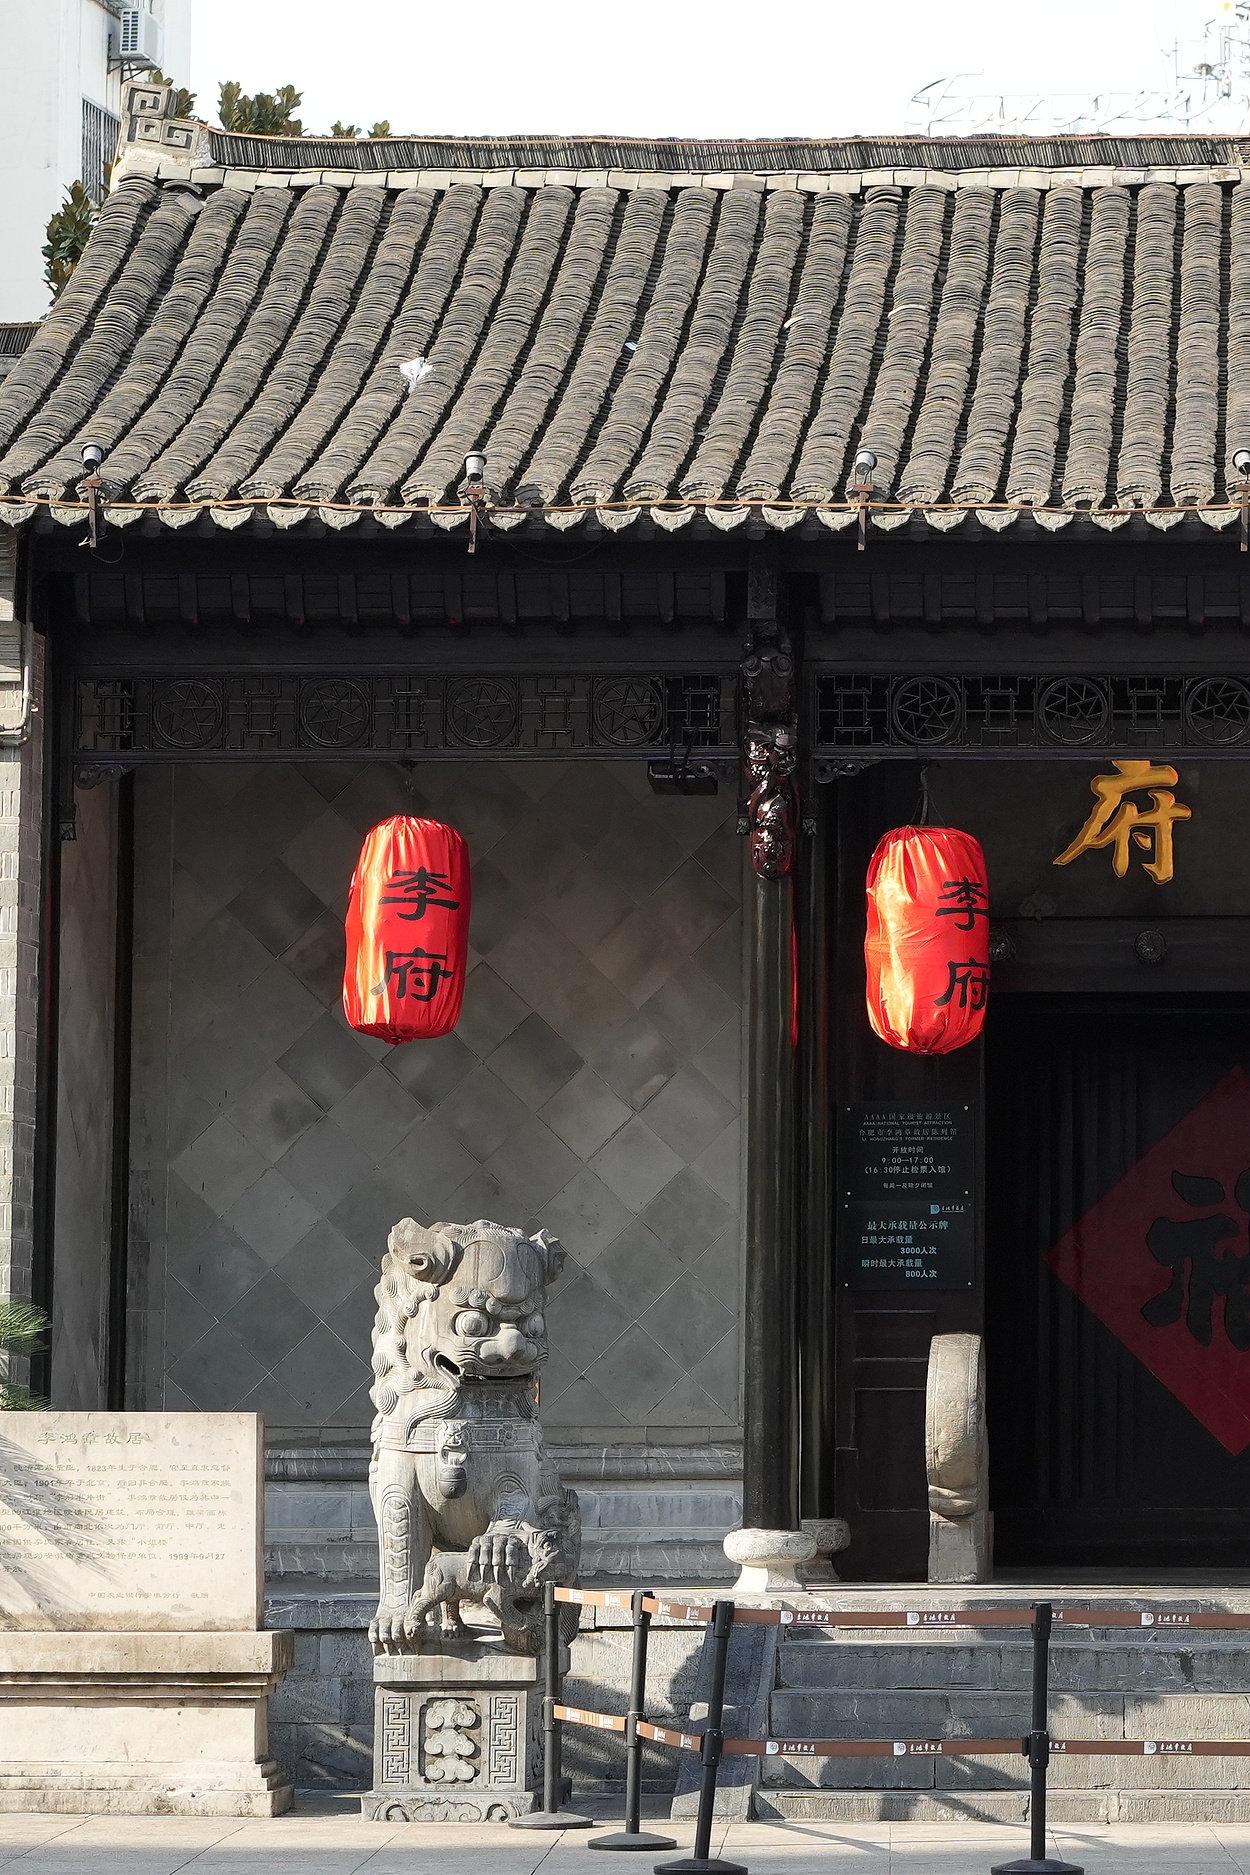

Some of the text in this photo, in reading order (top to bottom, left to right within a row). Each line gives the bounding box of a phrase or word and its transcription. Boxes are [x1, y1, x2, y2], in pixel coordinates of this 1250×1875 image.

[370, 866, 460, 1003] 李府
[932, 876, 990, 1012] 李府
[892, 1146, 924, 1155] 开放时间
[867, 1220, 949, 1231] 最大承载量公示牌
[861, 1236, 914, 1245] 日最大承载量
[900, 1246, 937, 1256] 3000人次
[861, 1259, 923, 1268] 瞬时最大承载量
[905, 1270, 938, 1279] 800人次
[37, 1431, 146, 1445] 李鸿章故居
